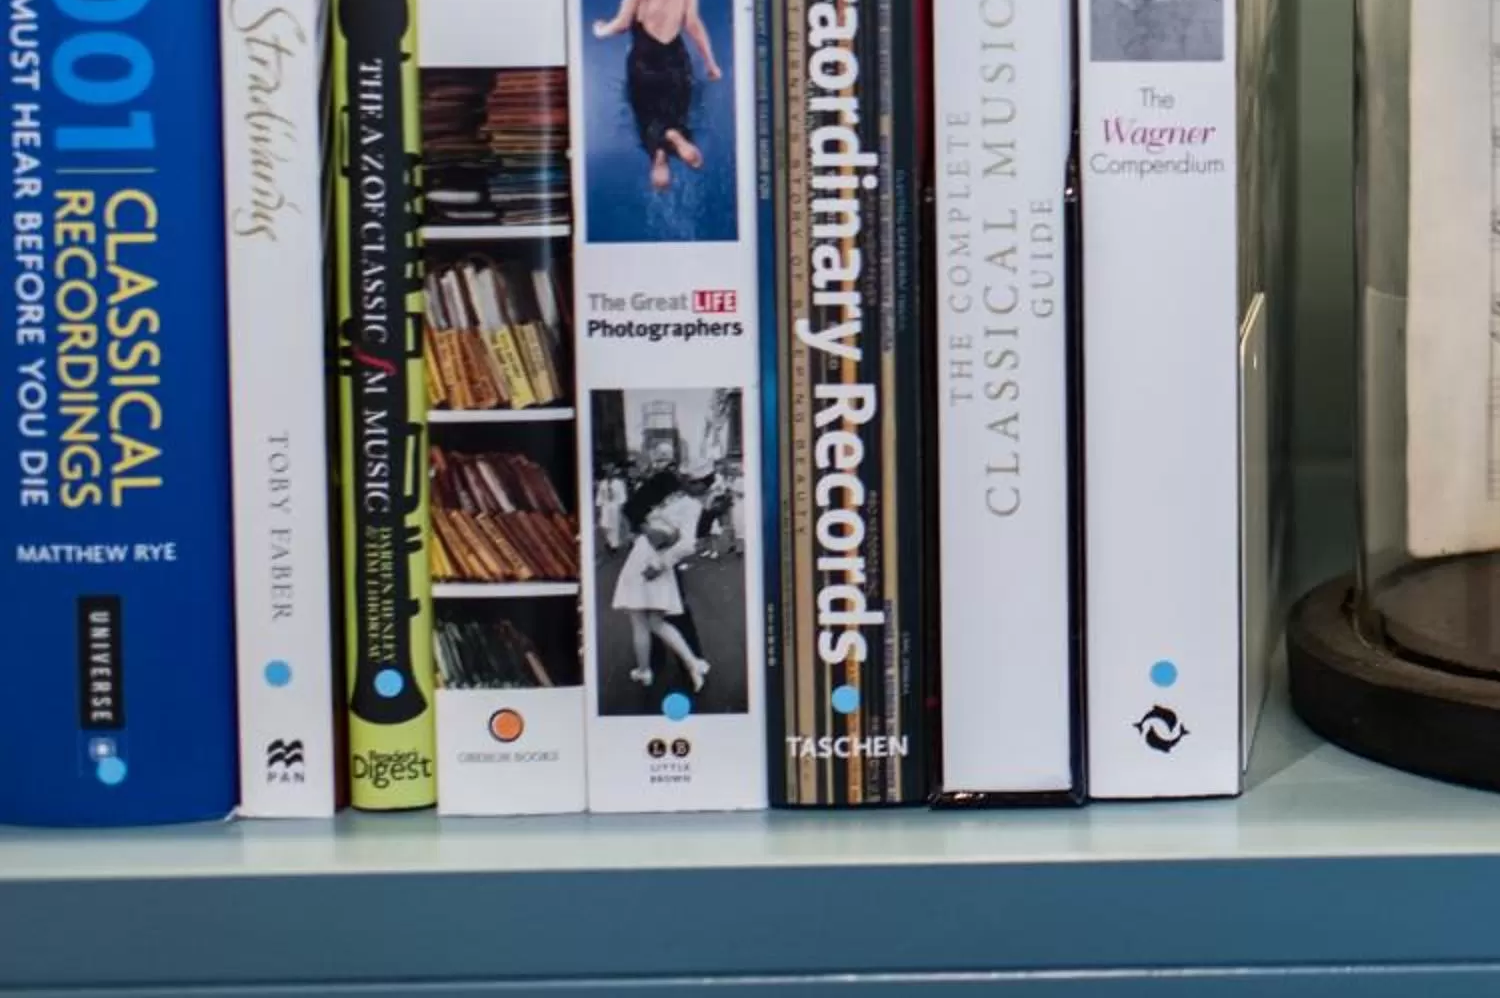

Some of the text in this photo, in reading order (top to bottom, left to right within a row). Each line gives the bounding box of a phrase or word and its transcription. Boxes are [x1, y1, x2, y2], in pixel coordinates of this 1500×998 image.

[358, 57, 384, 119] THE
[1138, 85, 1176, 110] The
[11, 103, 42, 200] HEAR
[1089, 150, 1225, 182] Compendium
[1102, 115, 1217, 154] Wagner
[361, 173, 386, 218] OF
[13, 211, 46, 346] BEFORE
[360, 219, 389, 344] CLASSIC
[945, 110, 973, 408] THE COMPLETE
[1030, 198, 1055, 320] GUIDE
[586, 318, 744, 342] Photographers
[587, 290, 737, 312] The Great LIFE
[53, 188, 102, 509] RECORDINGS
[103, 189, 164, 507] CLASSICAL
[982, 207, 1022, 518] CLASSICAL
[17, 357, 48, 438] YOU
[19, 450, 49, 507] DIE
[363, 409, 392, 514] MUSIC
[16, 542, 177, 564] MATTHEW RYE
[267, 431, 293, 622] TOBY FABER
[814, 382, 885, 666] Records
[88, 610, 114, 722] UNIVERSE
[266, 769, 306, 784] PAN
[351, 755, 433, 789] Digest
[786, 734, 909, 759] TASCHEN
